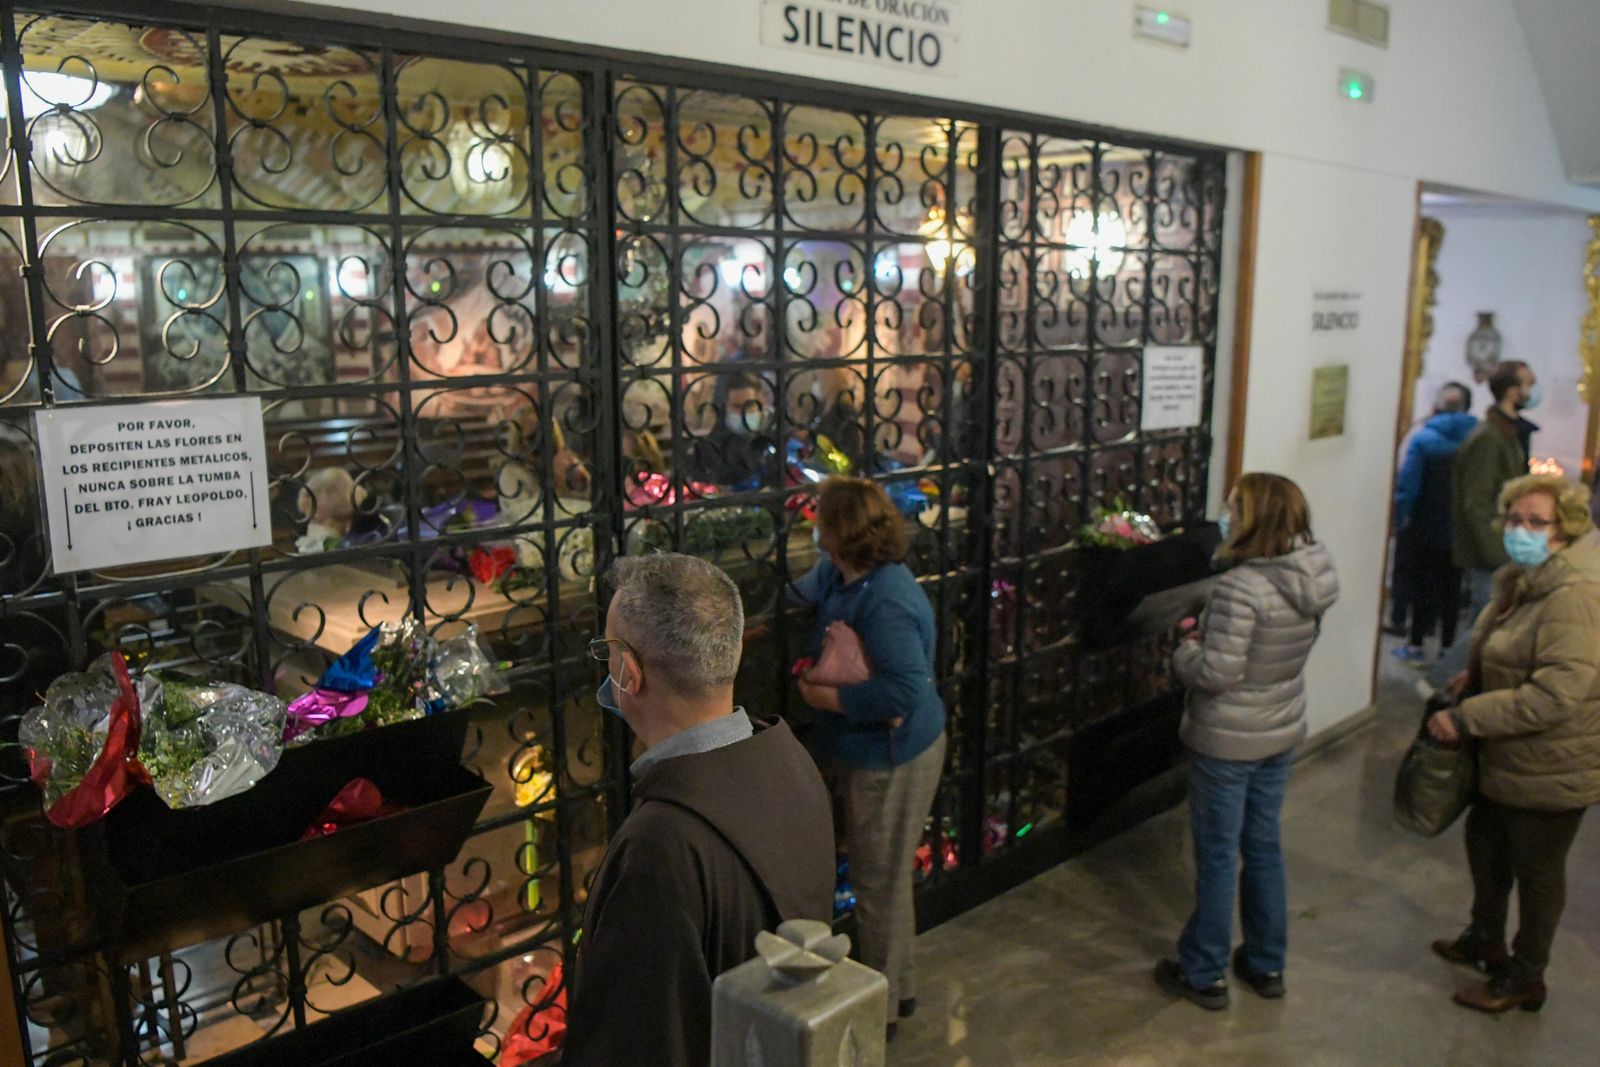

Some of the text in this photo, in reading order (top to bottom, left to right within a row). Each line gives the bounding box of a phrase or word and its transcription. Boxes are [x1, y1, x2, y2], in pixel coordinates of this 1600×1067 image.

[876, 0, 949, 24] ORACIÓN
[783, 5, 941, 67] SILENCIO
[117, 418, 196, 432] POR FAVOR,
[70, 433, 242, 455] DEPOSITEN LAS FLORES EN
[62, 451, 252, 475] LOS RECIPIENTES METALICOS,
[78, 470, 241, 494] NUNCA SOBRE LA TUMBA
[74, 503, 100, 515] DEL
[105, 500, 134, 511] BTO.
[138, 495, 172, 508] FRAY
[135, 514, 194, 528] GRACIAS
